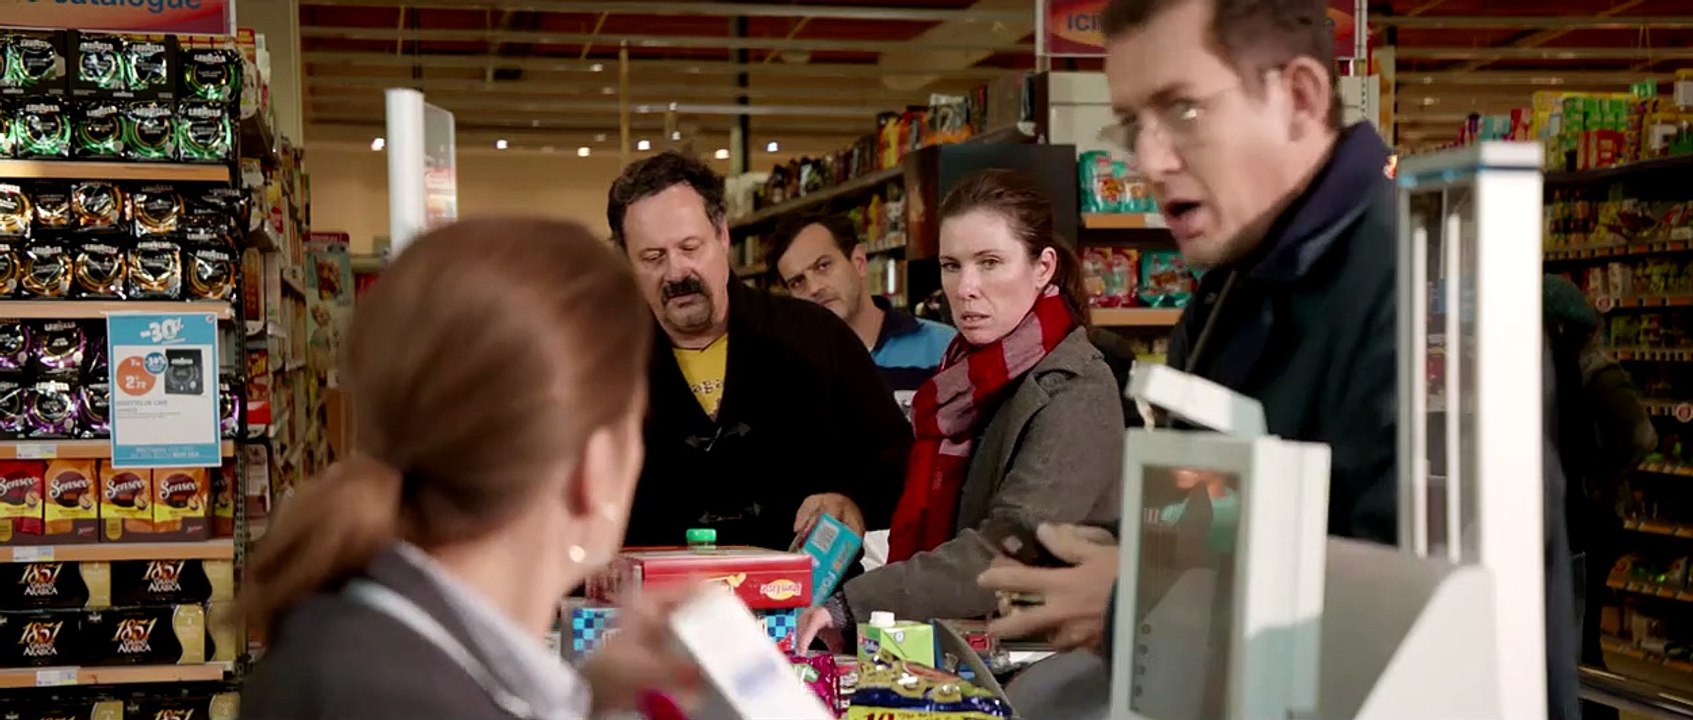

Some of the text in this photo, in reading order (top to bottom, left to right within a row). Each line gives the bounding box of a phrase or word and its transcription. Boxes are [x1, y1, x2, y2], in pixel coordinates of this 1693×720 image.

[18, 562, 63, 585] 1851
[142, 560, 185, 580] 1851
[17, 620, 64, 644] 1851
[112, 617, 157, 641] 1851
